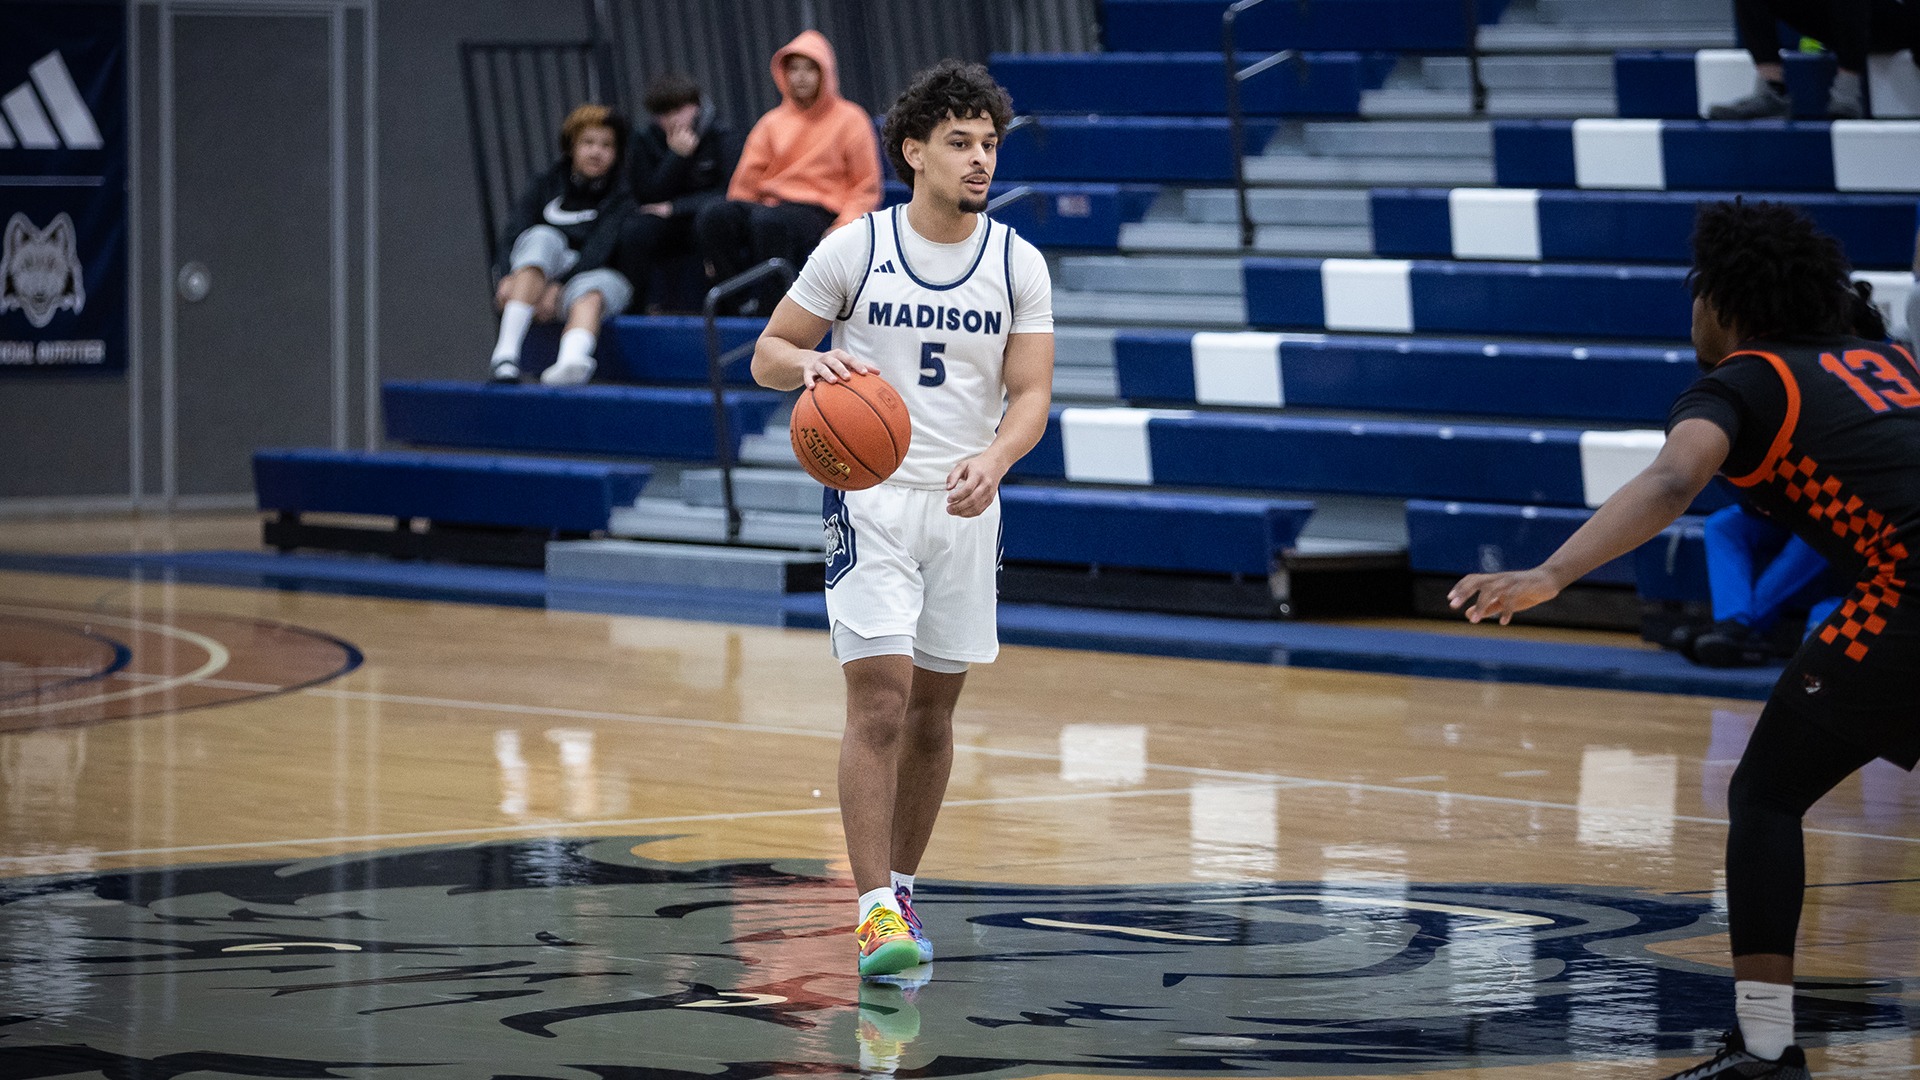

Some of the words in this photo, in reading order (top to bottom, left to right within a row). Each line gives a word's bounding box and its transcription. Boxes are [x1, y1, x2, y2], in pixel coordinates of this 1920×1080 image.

[868, 302, 1002, 334] MADISON
[918, 341, 947, 387] 5
[1818, 349, 1920, 413] 13
[801, 427, 849, 481] LEGACY
